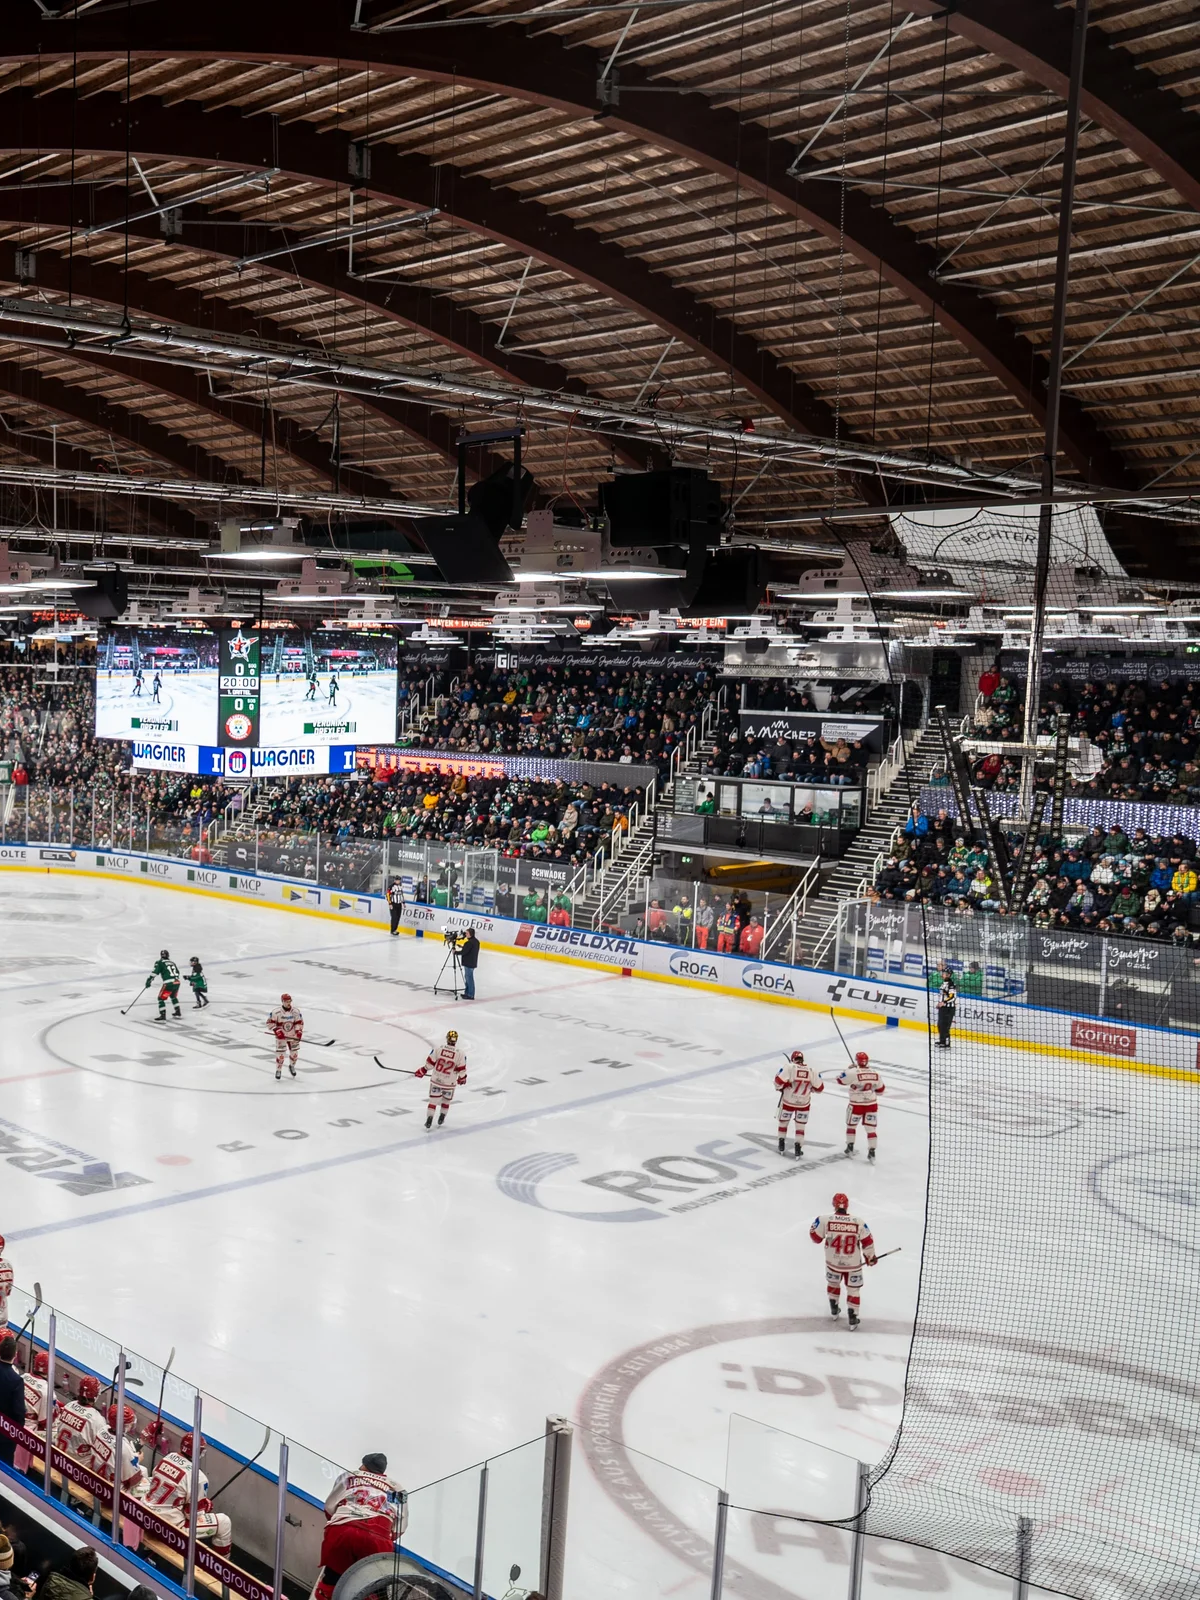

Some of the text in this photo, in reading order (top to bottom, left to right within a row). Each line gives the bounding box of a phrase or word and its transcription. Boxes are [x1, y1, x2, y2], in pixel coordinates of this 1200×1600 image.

[962, 531, 1038, 546] RICHTER
[498, 654, 507, 668] G
[235, 664, 244, 676] 0
[223, 678, 256, 687] 20:00
[235, 698, 244, 710] 0
[133, 741, 185, 763] WAGNER
[252, 749, 315, 767] WAGNER
[107, 857, 129, 868] MCP
[151, 864, 169, 875] MCP
[197, 873, 217, 883] MCP
[531, 867, 566, 881] SCHWADKE
[240, 880, 261, 891] MCP
[534, 927, 639, 956] SÜDELOXAL
[166, 965, 180, 978] 12
[679, 958, 719, 979] ROFA
[753, 974, 795, 993] ROFA
[848, 988, 919, 1010] CUBE
[1076, 1024, 1131, 1048] komro
[436, 1058, 455, 1075] 62
[793, 1080, 810, 1095] 77
[581, 1131, 837, 1205] ROFA
[830, 1223, 857, 1233] BERGMAN
[830, 1234, 857, 1254] 48
[646, 1339, 690, 1357] 1984
[618, 1356, 648, 1377] SEIT
[590, 1383, 621, 1453] ROSENHEIM
[600, 1459, 633, 1486] AUS
